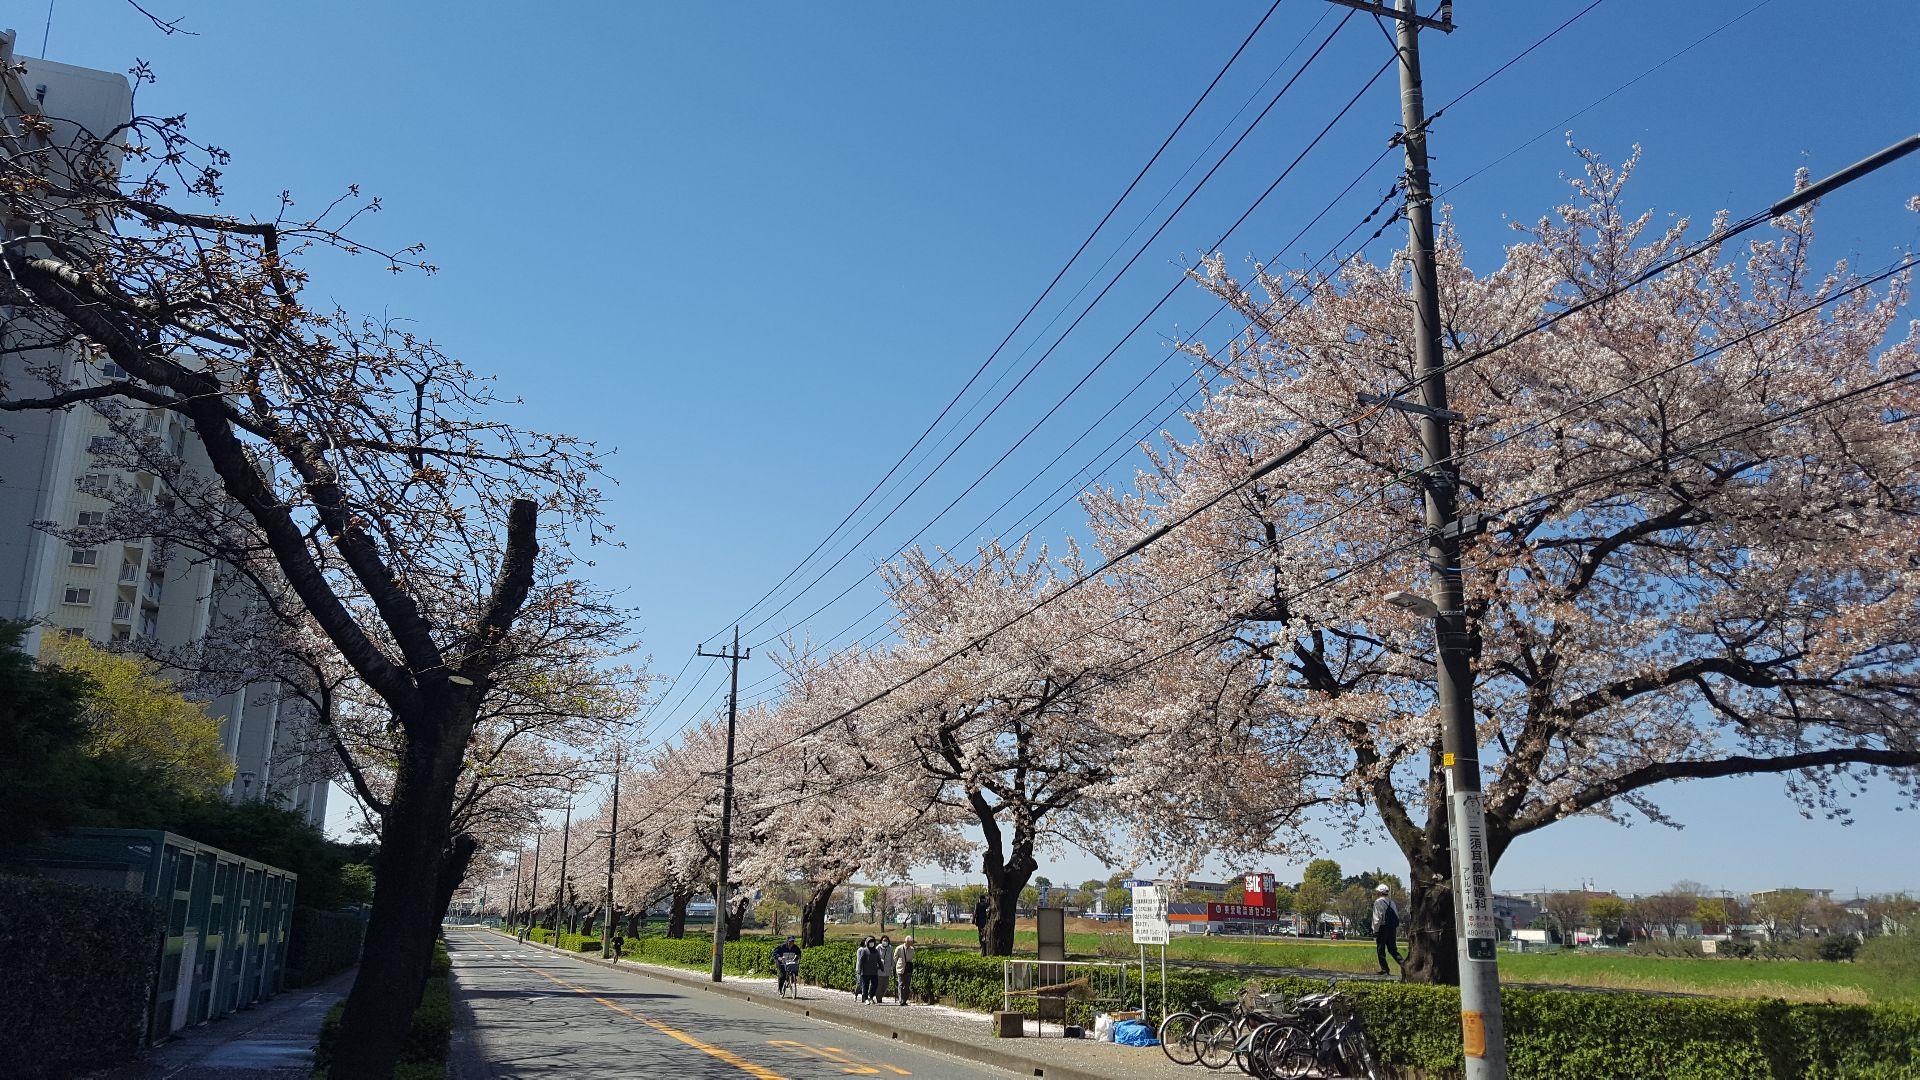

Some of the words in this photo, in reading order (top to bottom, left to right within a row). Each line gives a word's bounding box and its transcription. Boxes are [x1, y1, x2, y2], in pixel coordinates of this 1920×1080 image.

[1469, 825, 1487, 911] 三須耳鼻咽喉科
